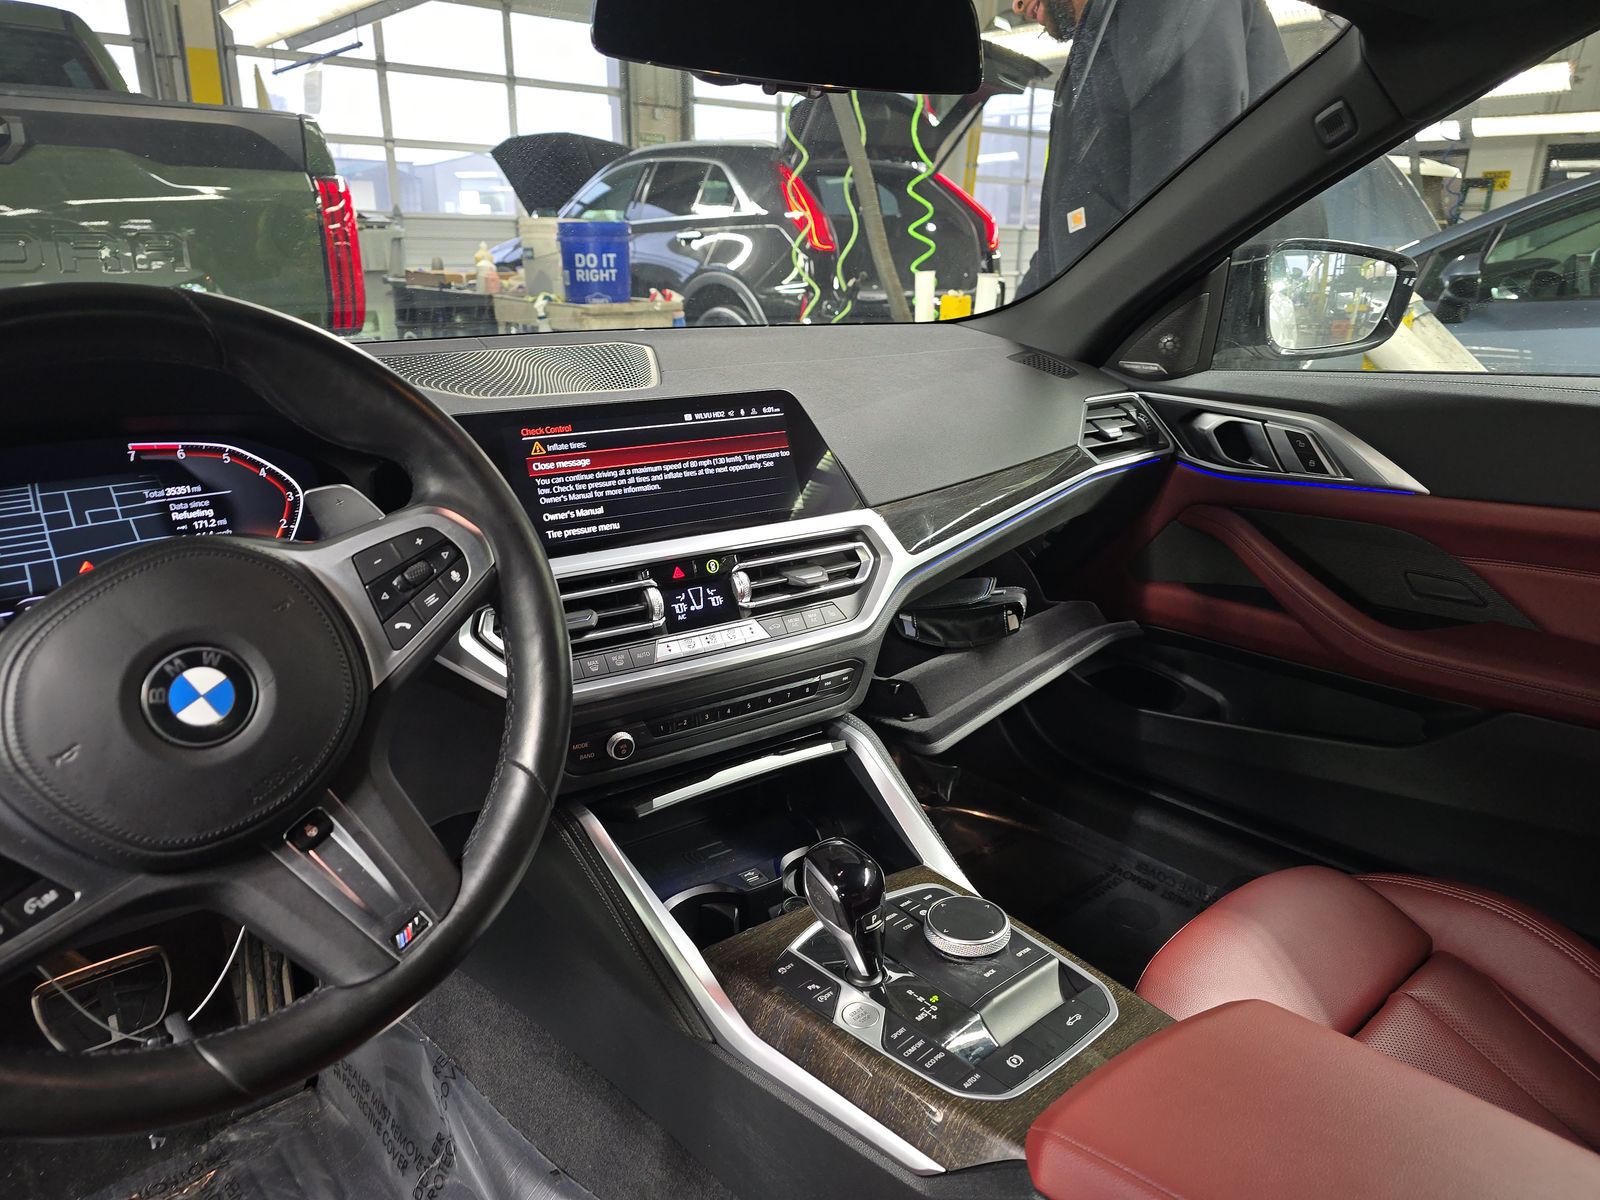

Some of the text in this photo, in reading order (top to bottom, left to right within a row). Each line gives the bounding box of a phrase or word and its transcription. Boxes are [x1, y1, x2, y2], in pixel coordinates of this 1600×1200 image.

[574, 252, 617, 268] DO IT
[576, 269, 618, 282] RIGHT
[521, 424, 573, 436] Check Control
[547, 442, 569, 452] Inflate
[127, 451, 136, 462] 7
[177, 449, 186, 460] 6
[222, 454, 231, 464] 5
[532, 457, 591, 471] Close message
[535, 477, 550, 486] You
[565, 472, 595, 482] continue
[595, 468, 618, 479] driving
[631, 465, 662, 474] maximum
[662, 462, 682, 472] speed
[698, 459, 712, 469] mph
[743, 454, 755, 462] Tire
[755, 451, 780, 461] pressure
[258, 468, 267, 478] 4
[537, 486, 552, 495] low.
[552, 483, 574, 493] Check
[575, 482, 587, 491] tire
[587, 479, 617, 490] pressure
[627, 476, 635, 484] all
[635, 475, 650, 483] tires
[650, 473, 663, 481] and
[663, 470, 683, 480] inflate
[683, 468, 697, 478] tires
[704, 466, 715, 475] the
[715, 465, 729, 474] next
[728, 462, 763, 473] opportunity.
[143, 485, 202, 499] Total 35351 mi
[286, 491, 295, 502] 3
[540, 494, 568, 505] Owner's
[568, 491, 594, 501] Manual
[594, 490, 604, 498] for
[623, 483, 662, 494] information.
[169, 499, 210, 511] Data since
[171, 508, 214, 520] Refueling
[543, 506, 604, 522] Owner's Manual
[193, 518, 228, 530] 171.2 mi
[279, 518, 289, 529] 2
[546, 521, 621, 539] Tire pressure menu
[148, 651, 222, 704] BMW
[890, 1027, 907, 1040] SPORT
[903, 1039, 926, 1057] COMFORT
[963, 1076, 976, 1088] AUTO
[340, 1059, 424, 1172] DEALER MUST REMOVE
[342, 1077, 408, 1176] PROTECTIVE COVER
